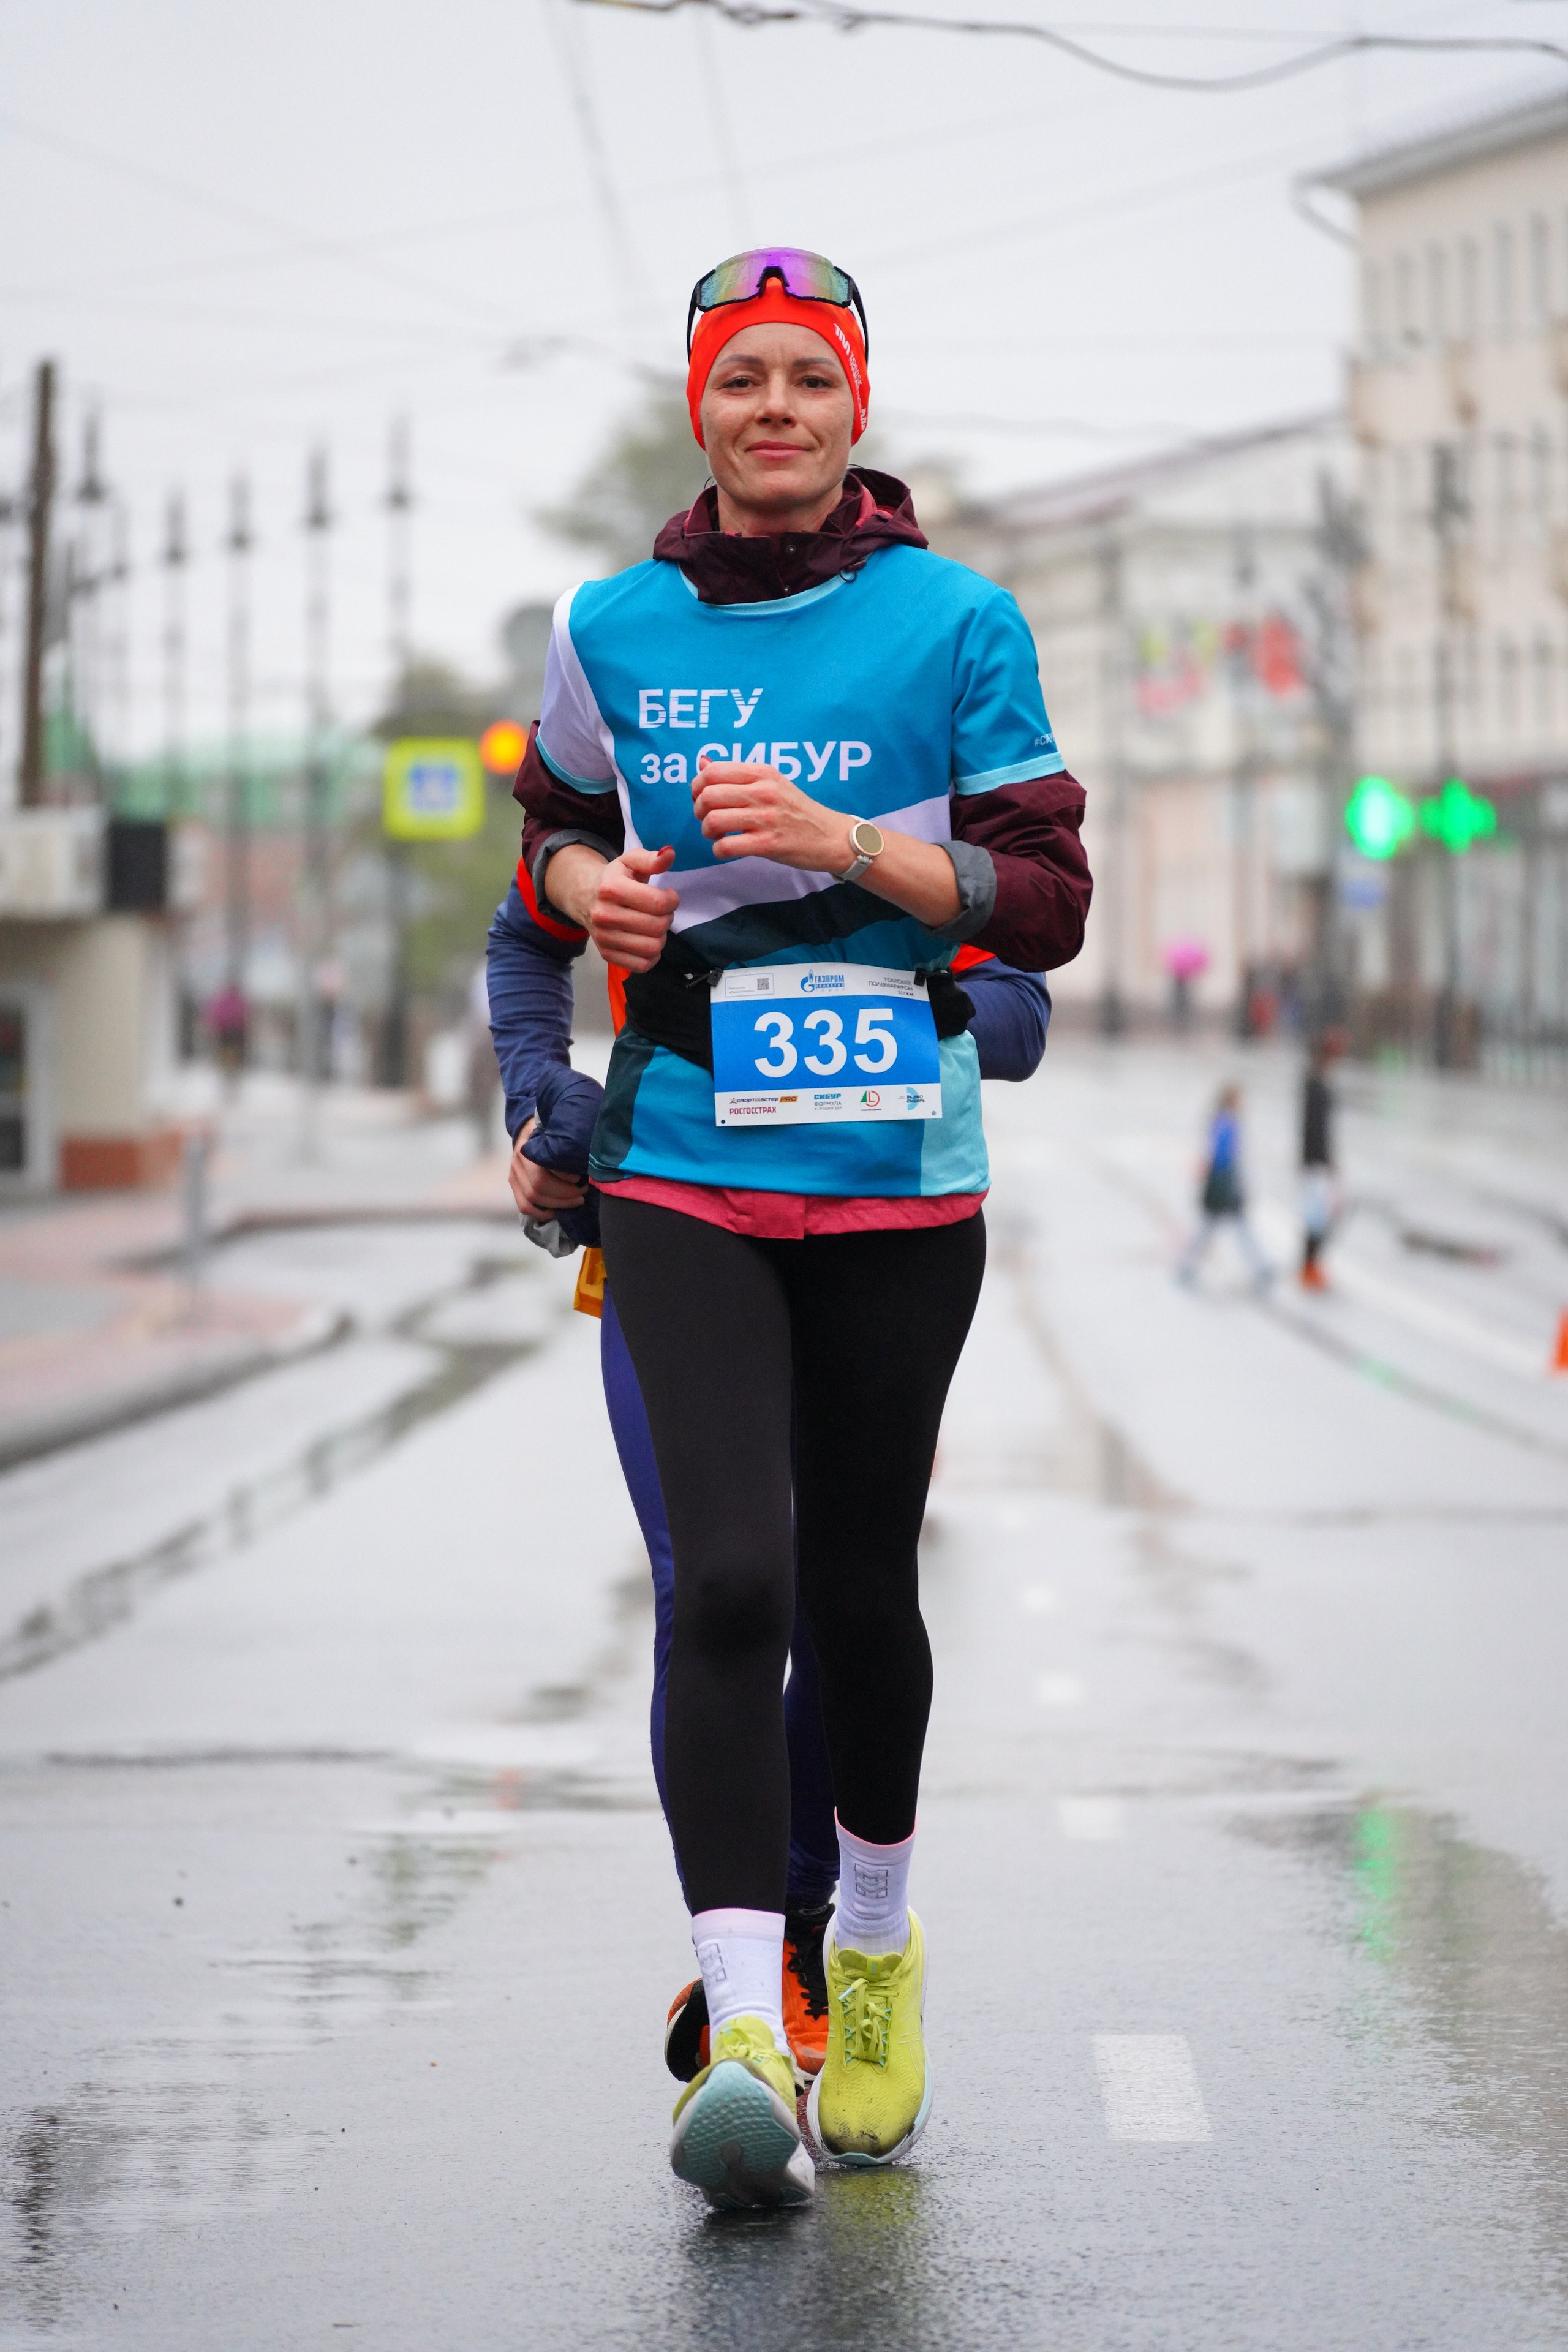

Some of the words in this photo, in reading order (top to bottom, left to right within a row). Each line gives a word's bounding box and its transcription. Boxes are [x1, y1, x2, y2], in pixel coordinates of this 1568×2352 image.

[639, 688, 763, 729] БЕГУ
[640, 753, 687, 783] за
[754, 1008, 898, 1078] 335
[729, 1106, 777, 1115] РОСГОССТРАХ
